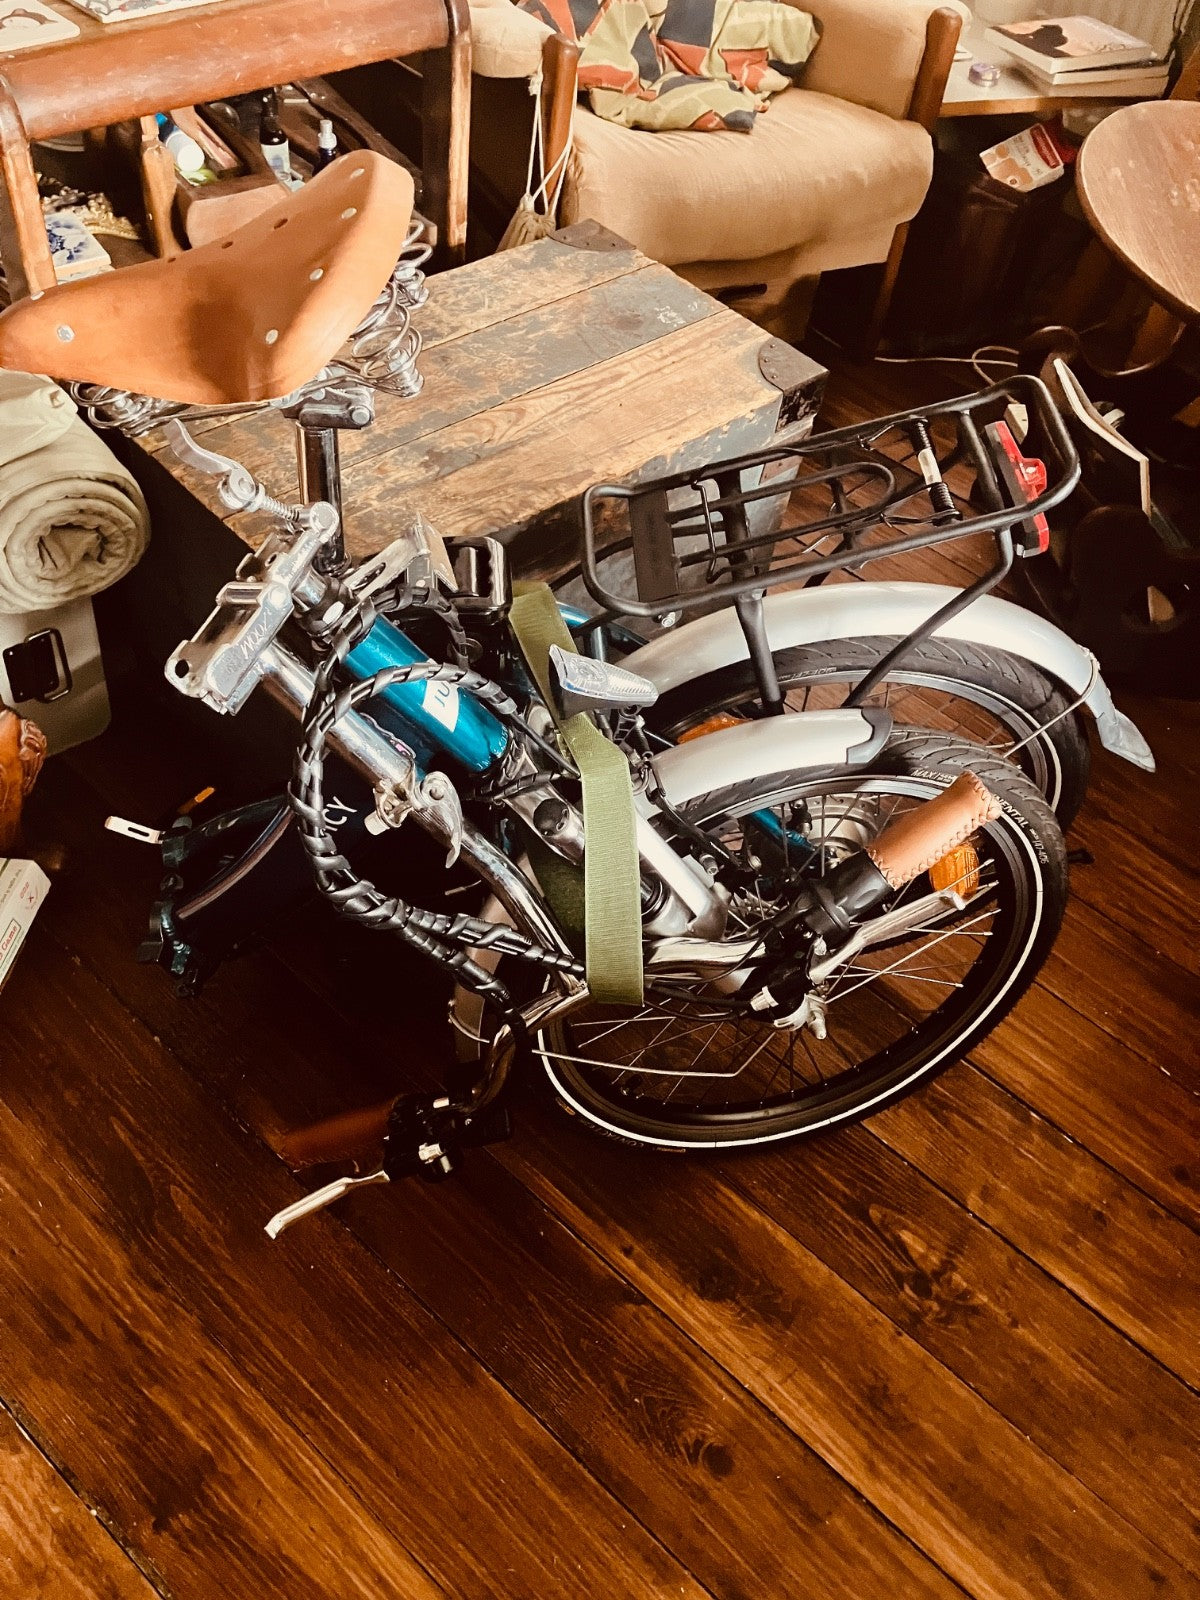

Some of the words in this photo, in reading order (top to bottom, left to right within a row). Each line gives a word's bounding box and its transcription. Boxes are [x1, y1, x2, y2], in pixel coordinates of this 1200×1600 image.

[434, 681, 450, 708] JU
[321, 796, 358, 836] ICY
[992, 794, 1029, 829] NENTAL
